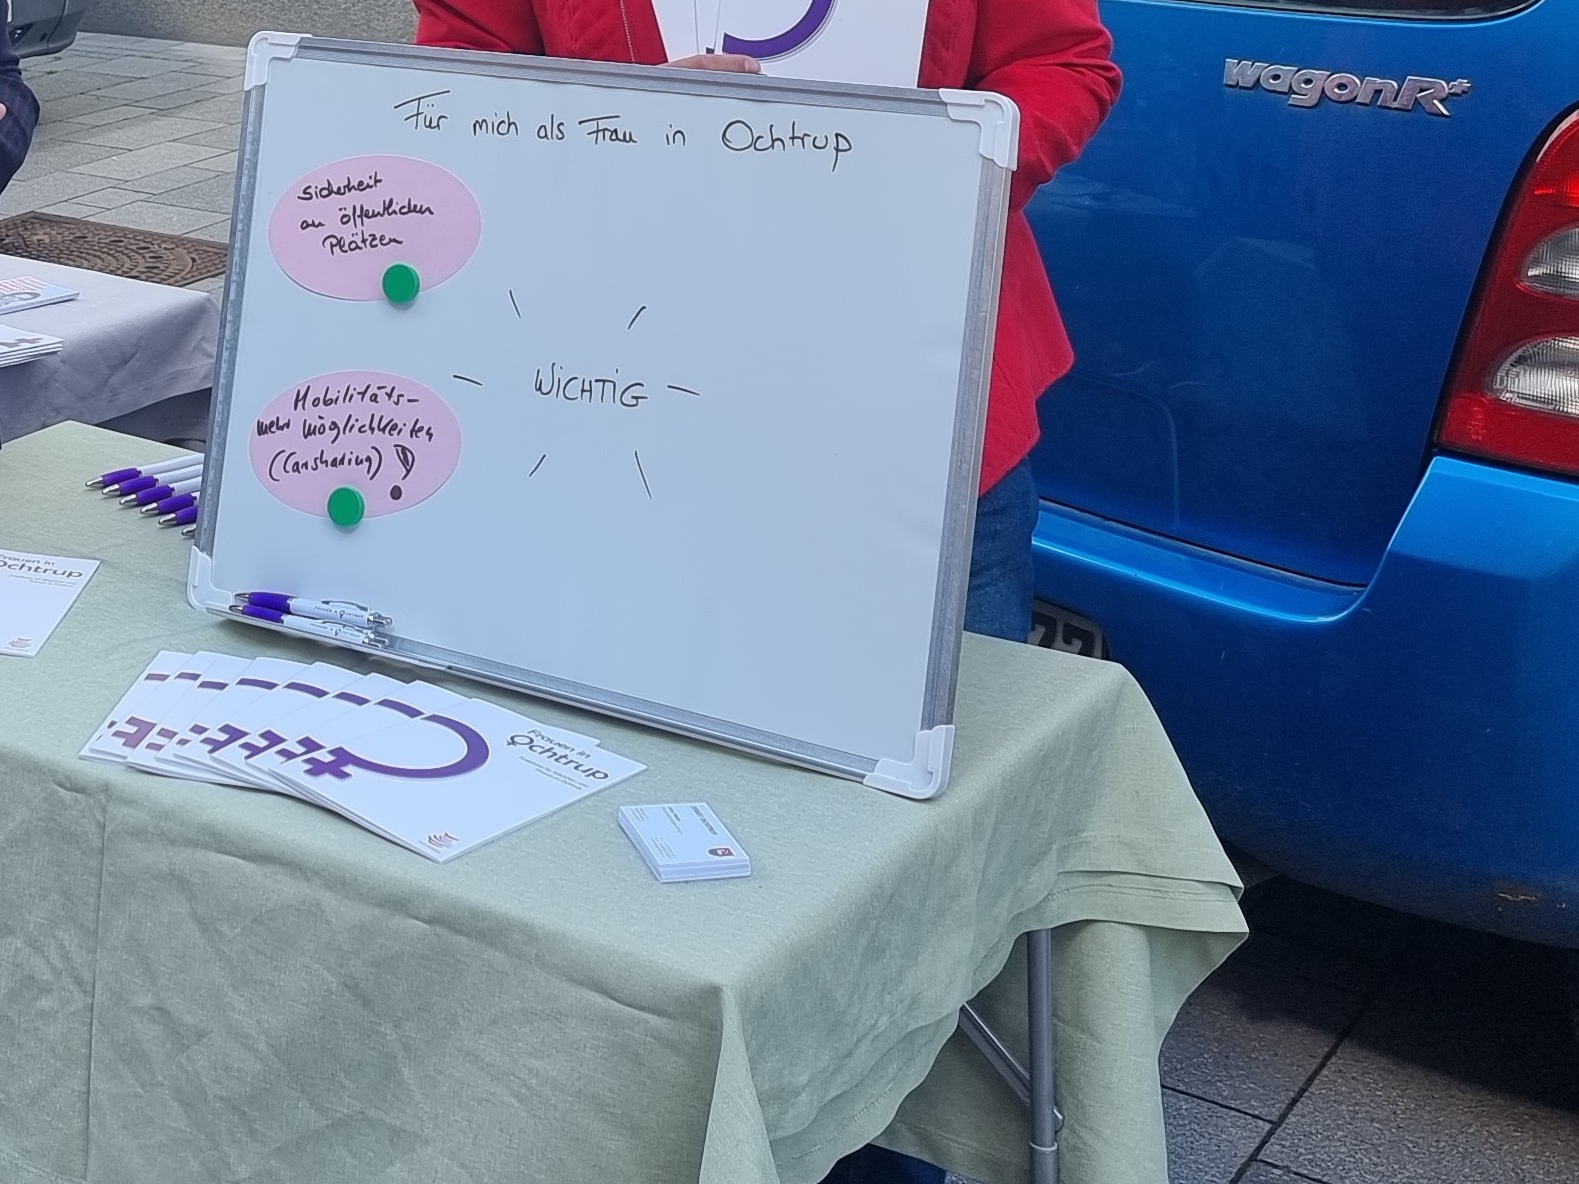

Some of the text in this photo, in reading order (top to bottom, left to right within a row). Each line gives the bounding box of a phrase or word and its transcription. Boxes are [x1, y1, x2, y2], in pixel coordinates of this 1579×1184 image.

[393, 89, 853, 173] Für mich als Frau in Ochtrup
[322, 230, 404, 256] Plätzen
